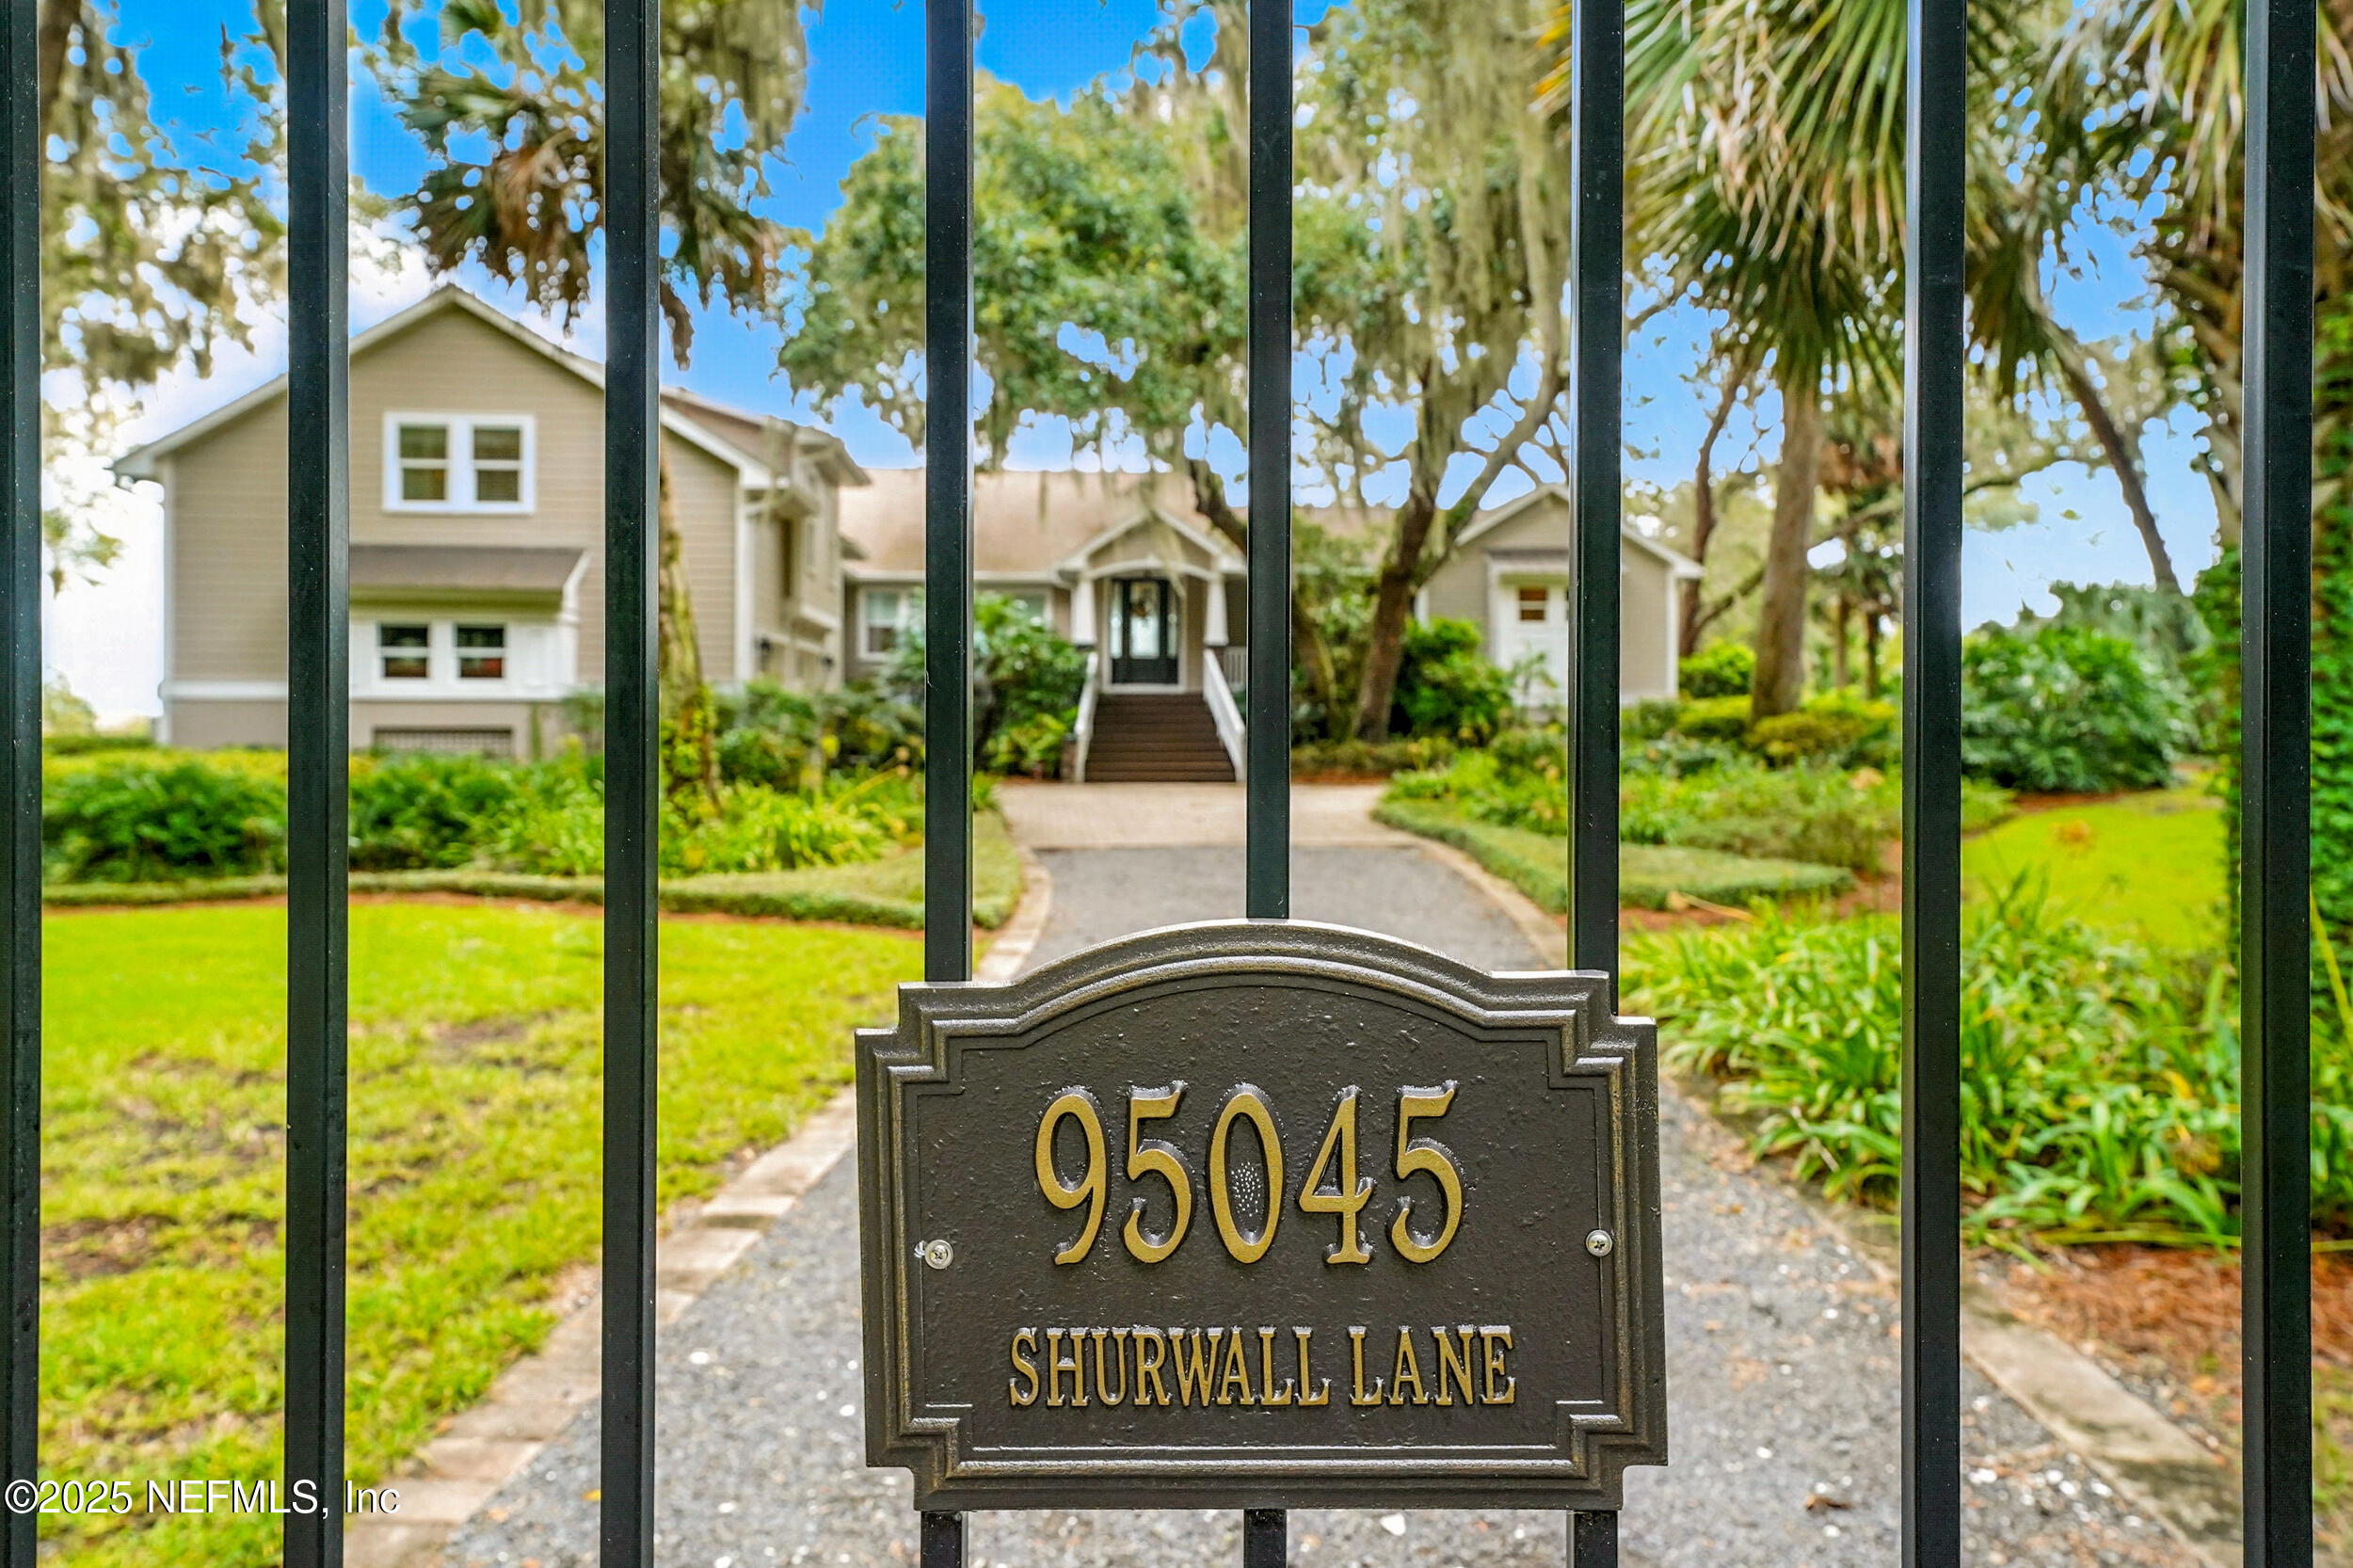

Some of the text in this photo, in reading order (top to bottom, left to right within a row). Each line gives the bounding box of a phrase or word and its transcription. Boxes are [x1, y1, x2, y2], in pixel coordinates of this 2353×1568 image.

[1035, 1082, 1465, 1265] 95045
[1009, 1326, 1516, 1408] SHURWALL LANE
